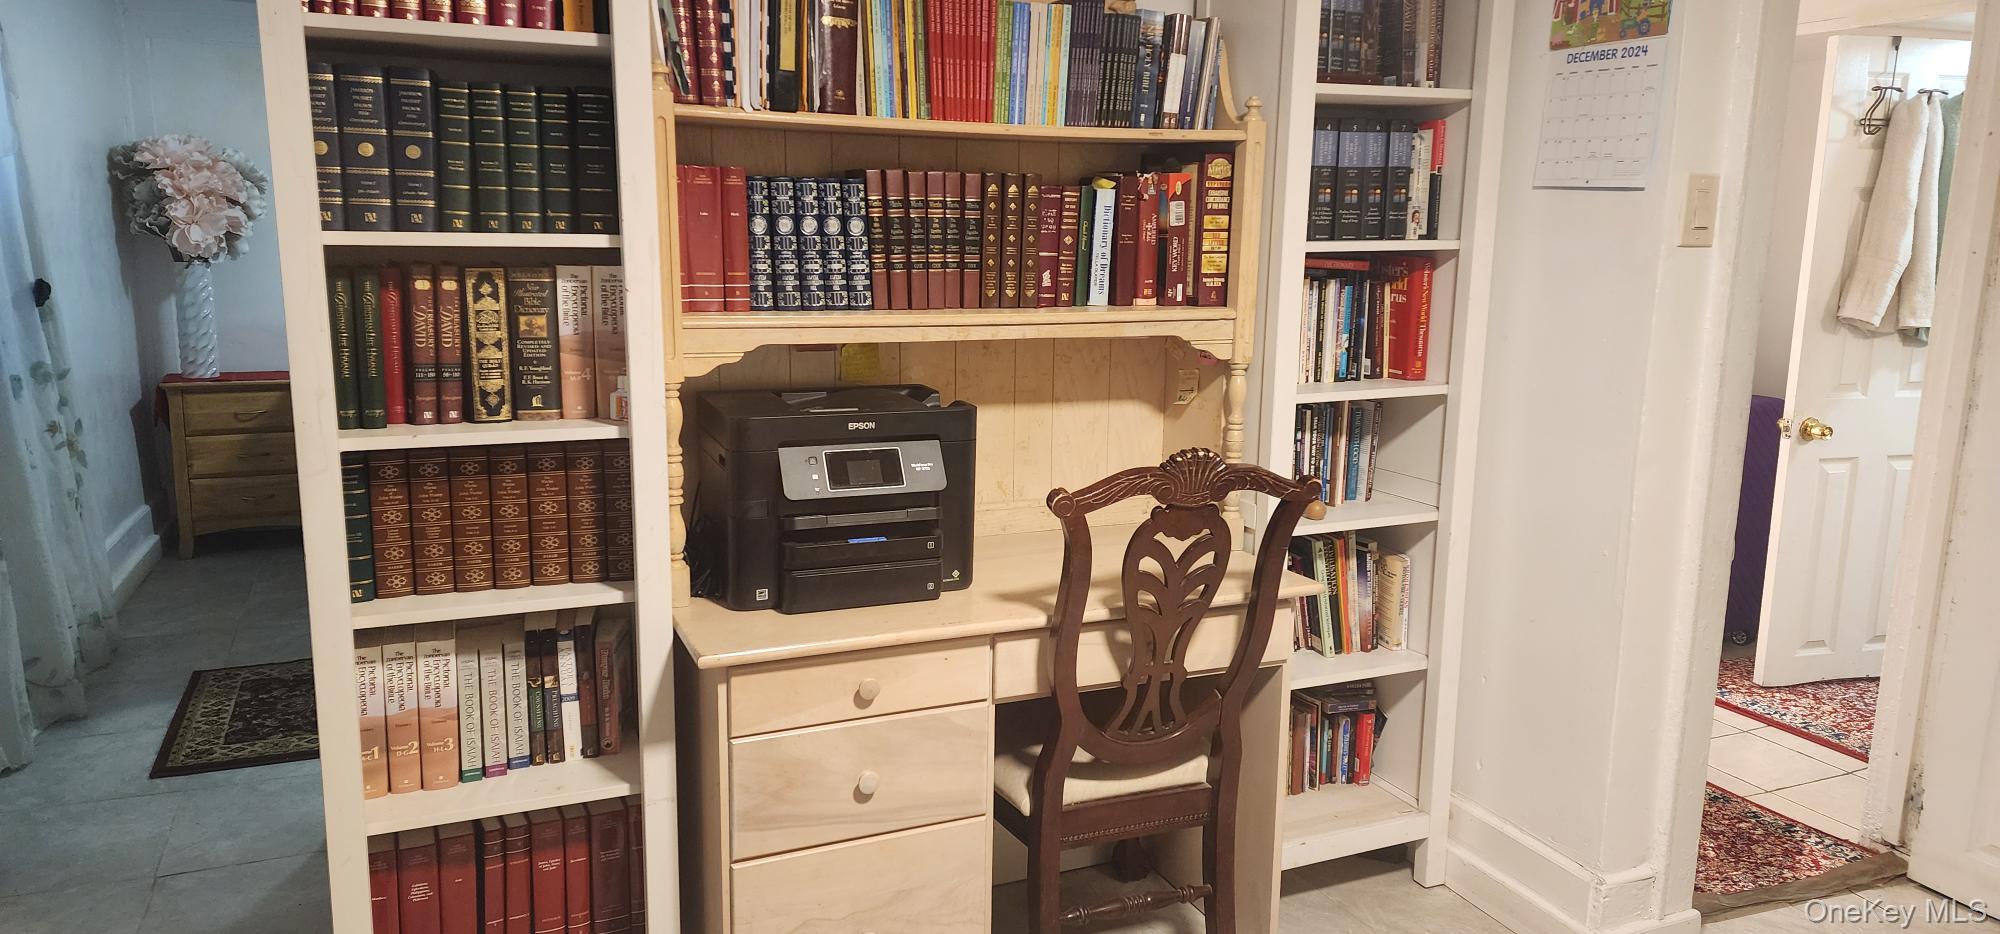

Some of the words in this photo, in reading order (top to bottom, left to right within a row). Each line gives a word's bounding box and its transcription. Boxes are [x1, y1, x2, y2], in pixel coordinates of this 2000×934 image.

[1144, 44, 1153, 69] HOLY
[1567, 49, 1618, 64] DECEMBER
[1621, 45, 1648, 59] 2024
[1142, 71, 1151, 95] BIBLE
[1100, 205, 1112, 249] Dictionary
[1100, 252, 1108, 261] of
[1098, 263, 1108, 295] Dreams
[1423, 262, 1431, 290] Webster's
[571, 285, 580, 336] Encyclopedia
[579, 285, 588, 316] Pictorial
[1420, 302, 1428, 322] World
[413, 305, 427, 348] DAVID
[440, 305, 453, 348] DAVID
[1417, 325, 1426, 357] Thesaurus
[581, 368, 592, 381] 4
[848, 421, 876, 430] EPSON
[386, 663, 392, 672] of
[406, 661, 414, 692] Pictorial
[423, 661, 430, 669] of
[423, 669, 431, 683] the
[442, 658, 451, 688] Pictorial
[511, 664, 520, 678] THE
[368, 666, 377, 696] Pictorial
[386, 672, 394, 686] the
[396, 662, 406, 712] Encyclopedia
[433, 659, 442, 708] Encyclopedia
[463, 673, 473, 689] THE
[487, 670, 497, 685] THE
[358, 666, 368, 716] Encyclopedia
[387, 686, 395, 704] Bible
[424, 683, 432, 700] Bible
[512, 683, 522, 710] BOOK
[465, 693, 475, 720] BOOK
[488, 690, 498, 717] BOOK
[465, 722, 475, 736] OF
[489, 718, 499, 731] OF
[513, 711, 523, 723] OF
[407, 741, 419, 755] 2
[444, 737, 454, 752] 3
[466, 737, 477, 768] ISAIAH
[491, 733, 501, 763] ISAIAH
[514, 726, 524, 755] ISAIAH
[371, 746, 379, 760] 1
